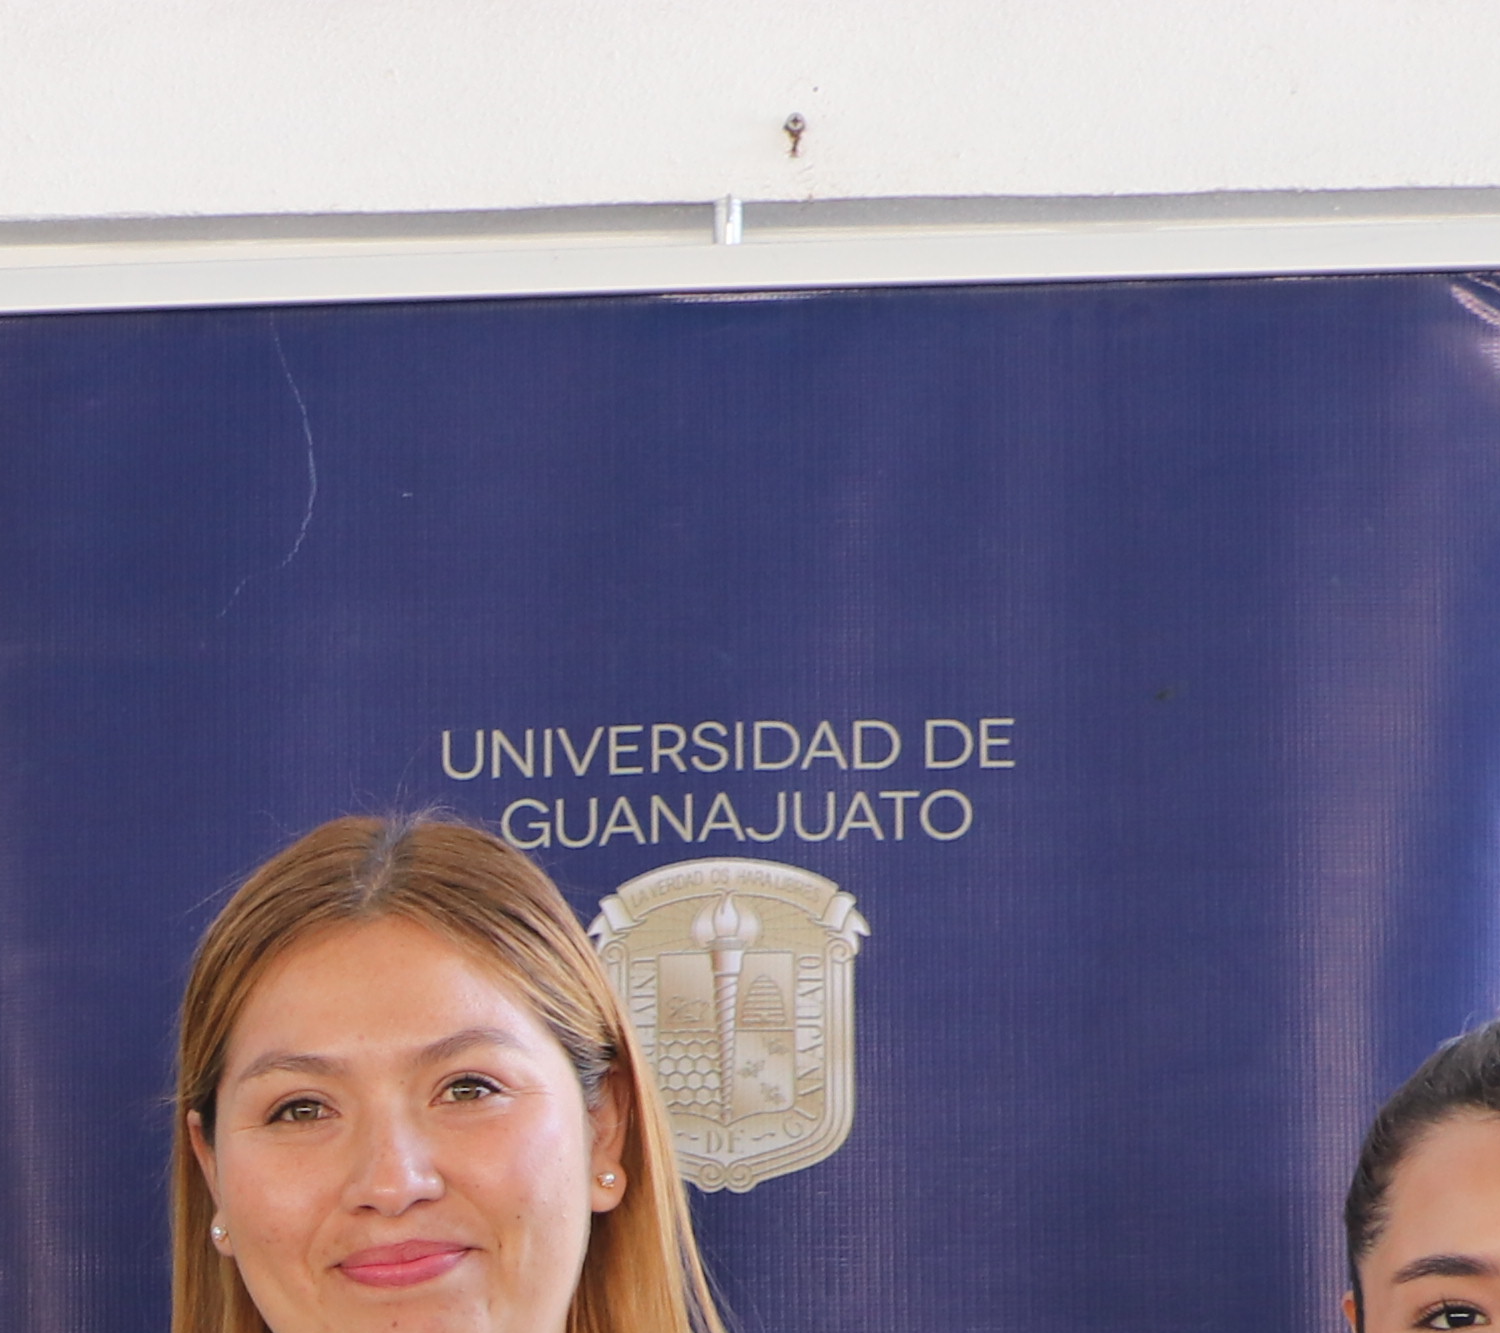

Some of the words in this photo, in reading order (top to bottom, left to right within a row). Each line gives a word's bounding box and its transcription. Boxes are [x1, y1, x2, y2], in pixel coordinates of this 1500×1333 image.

[441, 719, 900, 781] UNIVERSIDAD
[924, 718, 1016, 769] DE
[500, 788, 974, 850] GUANAJUATO
